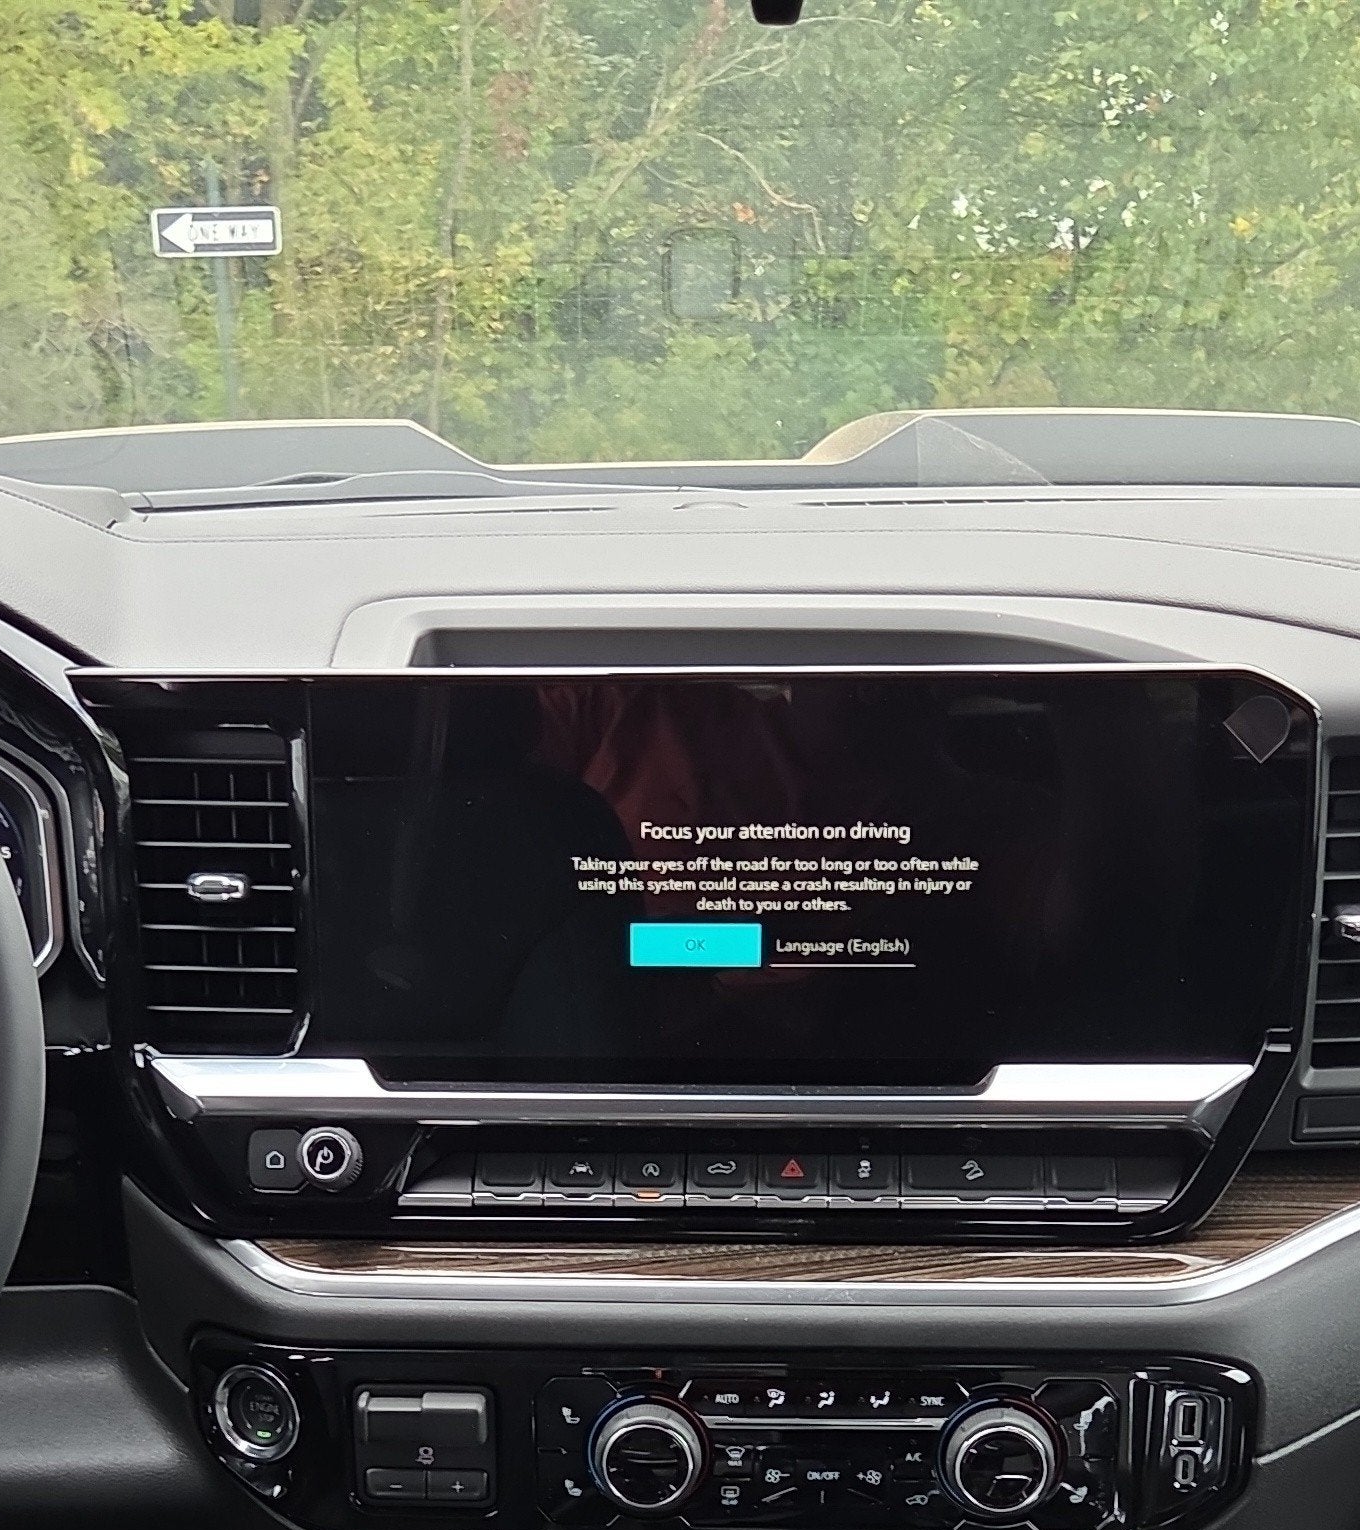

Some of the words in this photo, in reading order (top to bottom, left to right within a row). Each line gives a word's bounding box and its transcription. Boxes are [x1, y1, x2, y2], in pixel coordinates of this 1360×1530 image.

[640, 821, 693, 840] Focus
[694, 826, 735, 844] your
[738, 822, 819, 840] attention
[822, 826, 846, 839] on
[849, 820, 911, 844] driving
[570, 856, 617, 875] Taking
[618, 860, 650, 875] your
[651, 860, 685, 875] eyes
[686, 856, 709, 871] off
[710, 856, 734, 871] the
[736, 856, 769, 871] road
[770, 856, 793, 871] for
[793, 858, 819, 871] too
[821, 856, 853, 875] long
[855, 860, 872, 871] or
[873, 858, 898, 871] too
[899, 856, 939, 871] often
[941, 856, 980, 871] while
[578, 877, 617, 894] using
[618, 876, 645, 891] this
[646, 879, 697, 894] system
[698, 876, 737, 891] could
[738, 880, 780, 891] cause
[781, 880, 792, 891] a
[793, 876, 831, 891] crash
[833, 877, 896, 894] resulting
[897, 877, 912, 891] in
[913, 877, 955, 894] injury
[955, 880, 973, 891] or
[696, 896, 737, 911] death
[738, 898, 754, 911] to
[755, 900, 782, 915] you
[783, 900, 800, 911] or
[801, 896, 853, 911] others.
[685, 938, 707, 951] OK
[775, 938, 844, 956] Language
[847, 937, 910, 956] (English)
[715, 1393, 740, 1405] AUTO
[920, 1395, 945, 1407] SYNC
[904, 1452, 924, 1462] A/C
[806, 1470, 841, 1481] ON/OFF
